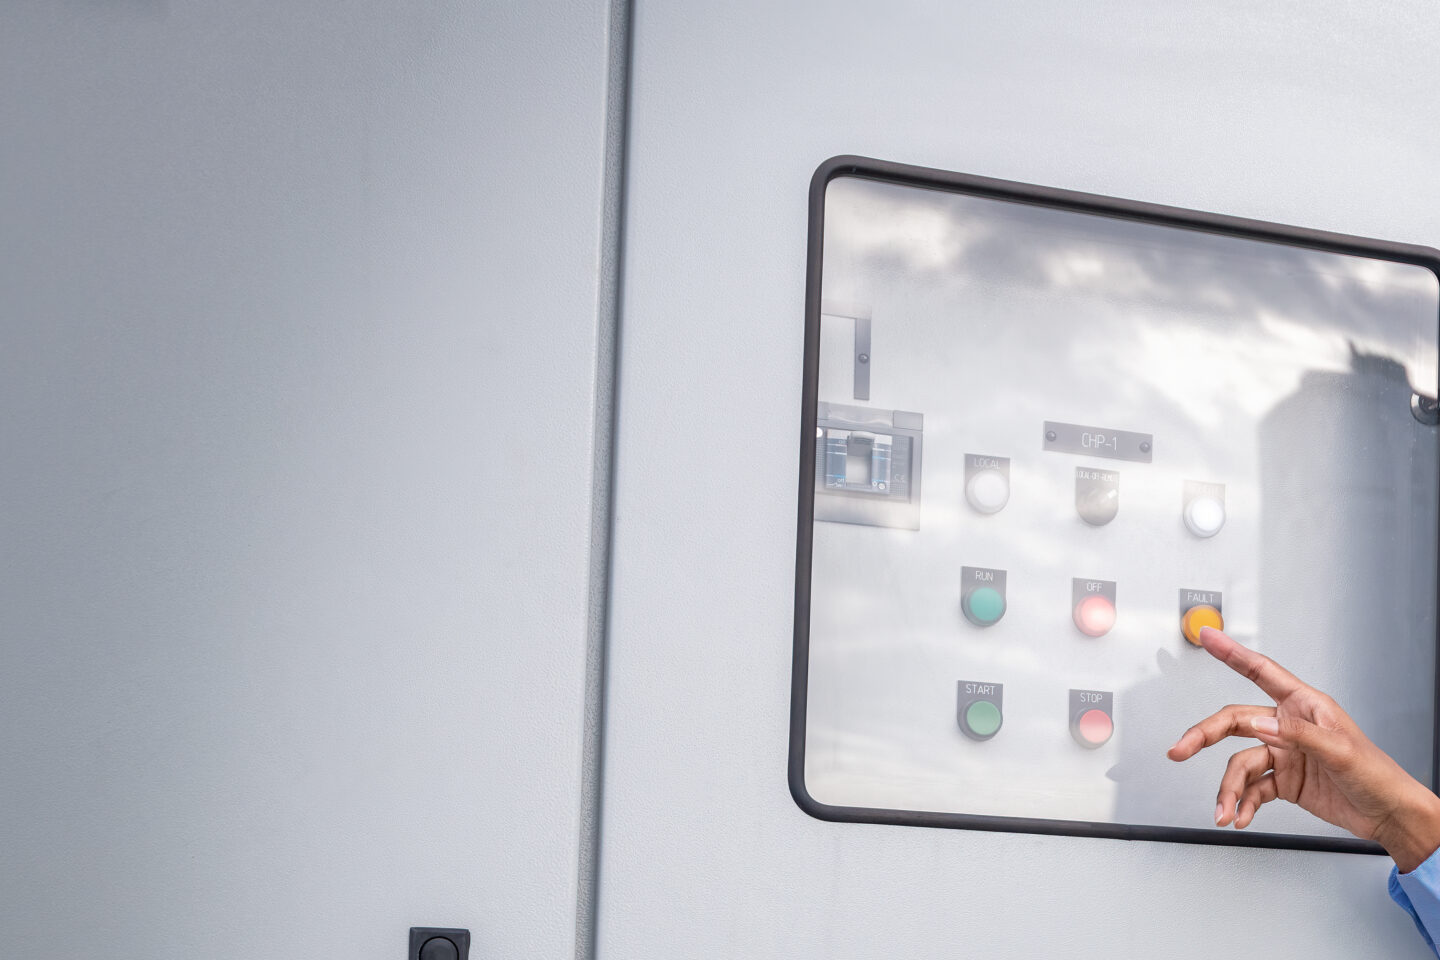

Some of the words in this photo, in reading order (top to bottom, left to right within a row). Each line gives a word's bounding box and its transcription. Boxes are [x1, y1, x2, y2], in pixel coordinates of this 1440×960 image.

[1081, 432, 1117, 451] CHP-1
[974, 457, 1000, 470] LOCAL
[975, 570, 993, 581] RUN
[1086, 582, 1102, 592] OFF
[1187, 592, 1214, 603] FAULT
[966, 683, 995, 696] START
[1080, 692, 1103, 703] STOP
